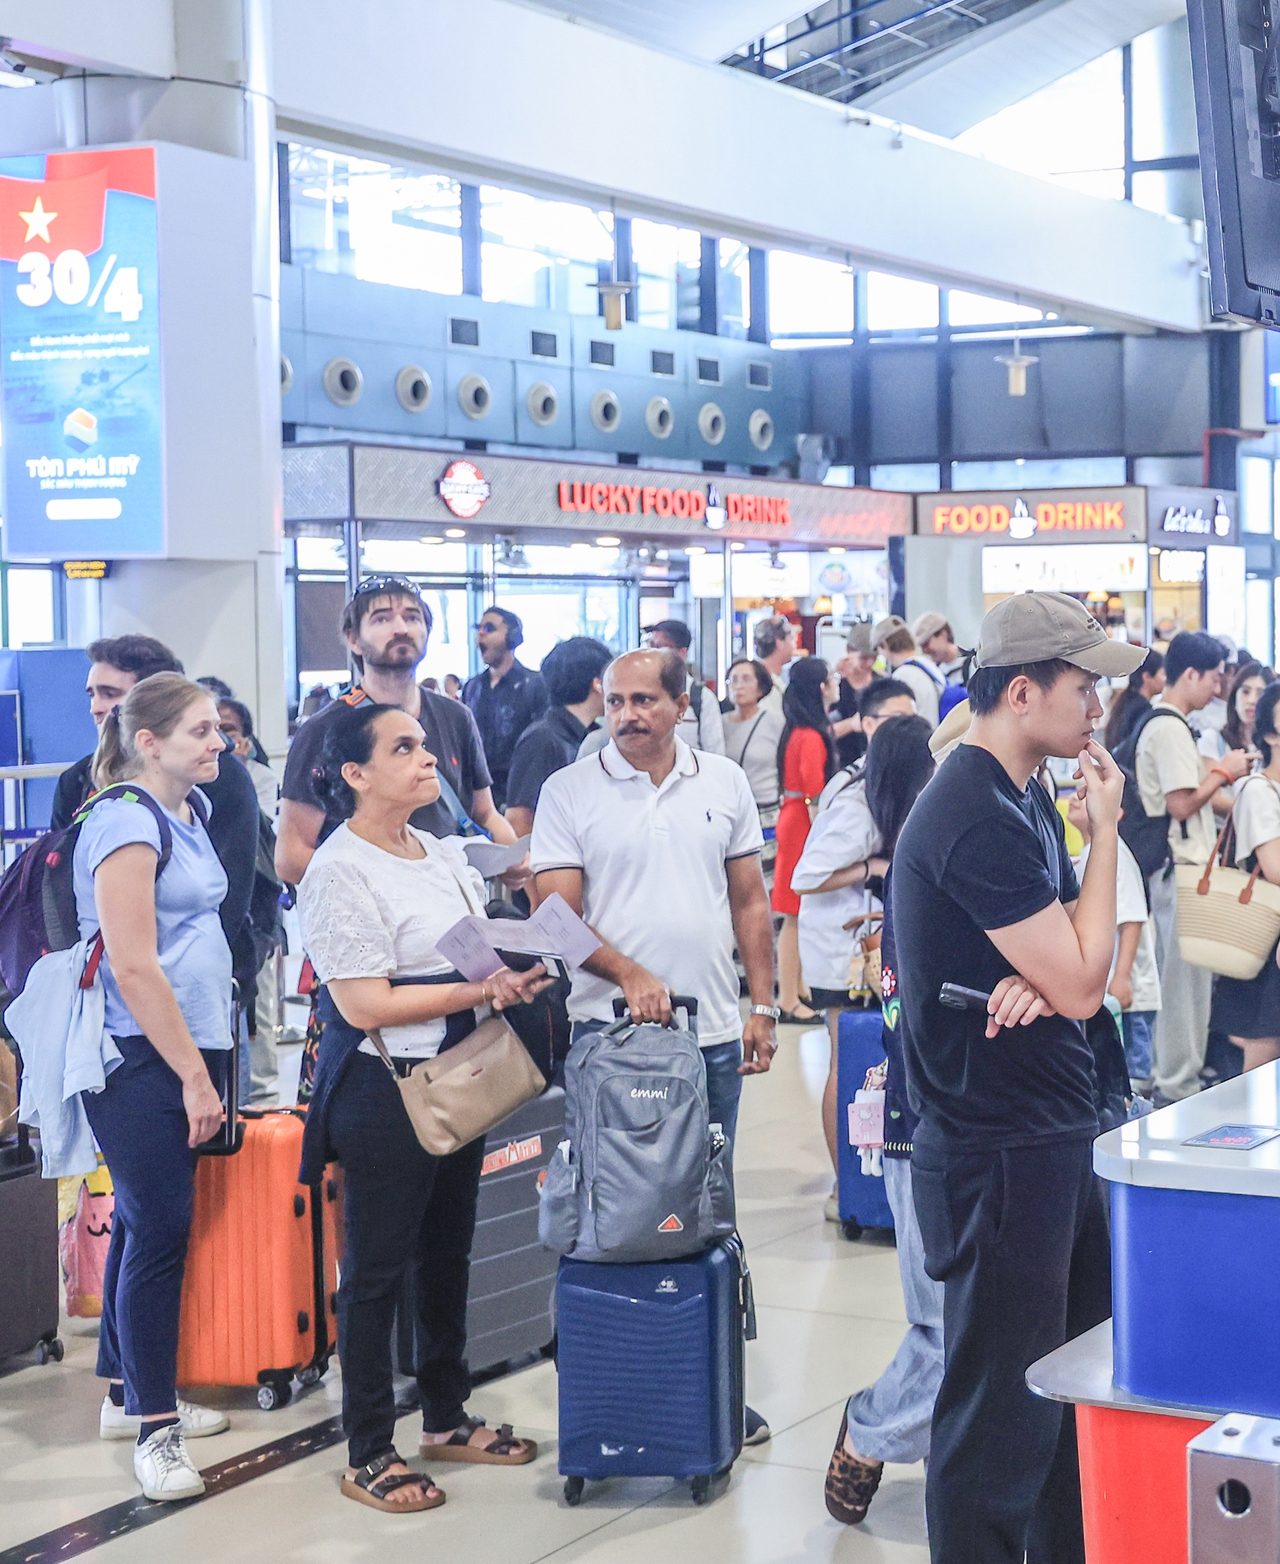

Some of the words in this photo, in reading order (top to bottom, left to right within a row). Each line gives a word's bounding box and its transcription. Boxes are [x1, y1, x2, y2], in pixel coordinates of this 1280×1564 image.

[16, 249, 143, 322] 30/4
[558, 480, 641, 515] LUCKY
[641, 485, 706, 520] FOOD
[727, 493, 793, 526] DRINK
[932, 503, 1010, 534] FOOD
[1036, 499, 1127, 532] DRINK
[630, 1086, 669, 1100] emmi
